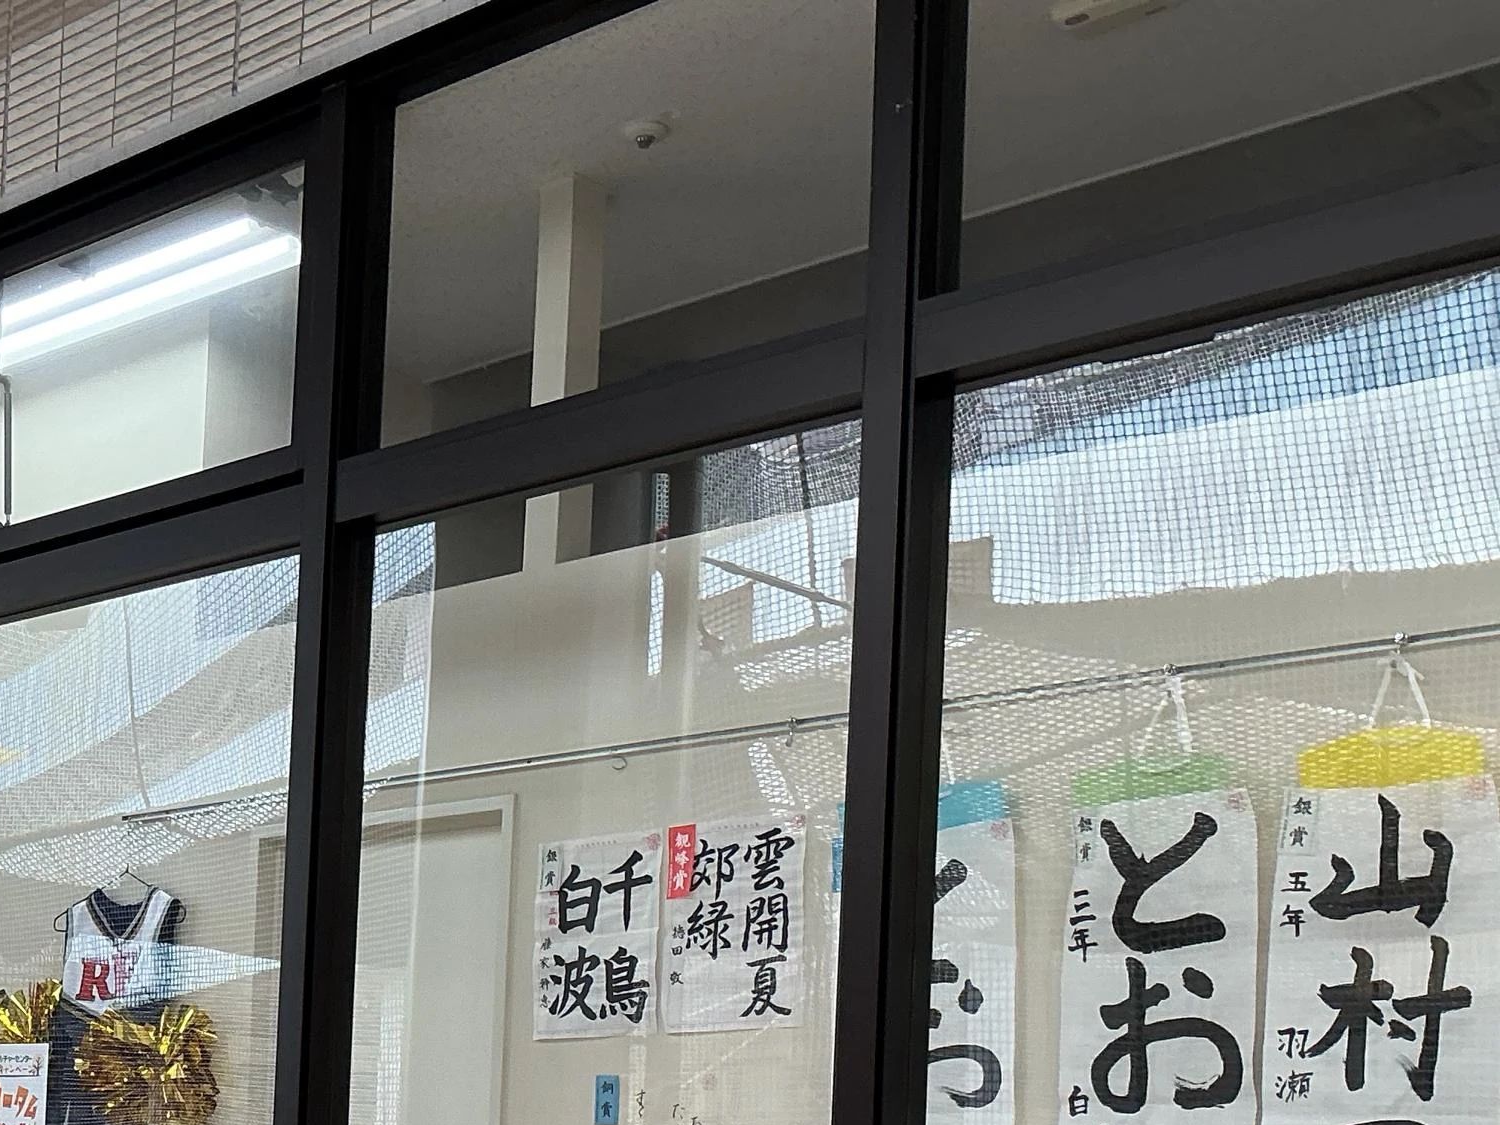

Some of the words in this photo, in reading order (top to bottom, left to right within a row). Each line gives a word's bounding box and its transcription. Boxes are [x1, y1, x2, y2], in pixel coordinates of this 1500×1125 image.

[1077, 816, 1093, 863] 銀賞
[1290, 797, 1313, 847] 銀賞
[544, 849, 559, 887] 銀賞
[686, 839, 740, 960] 郊緑
[1280, 871, 1312, 938] 五年
[549, 864, 603, 1021] 白波
[600, 850, 654, 1024] 千鳥
[739, 827, 796, 1018] 雲開夏
[1068, 889, 1099, 963] 三年
[1275, 1027, 1314, 1102] 羽瀬
